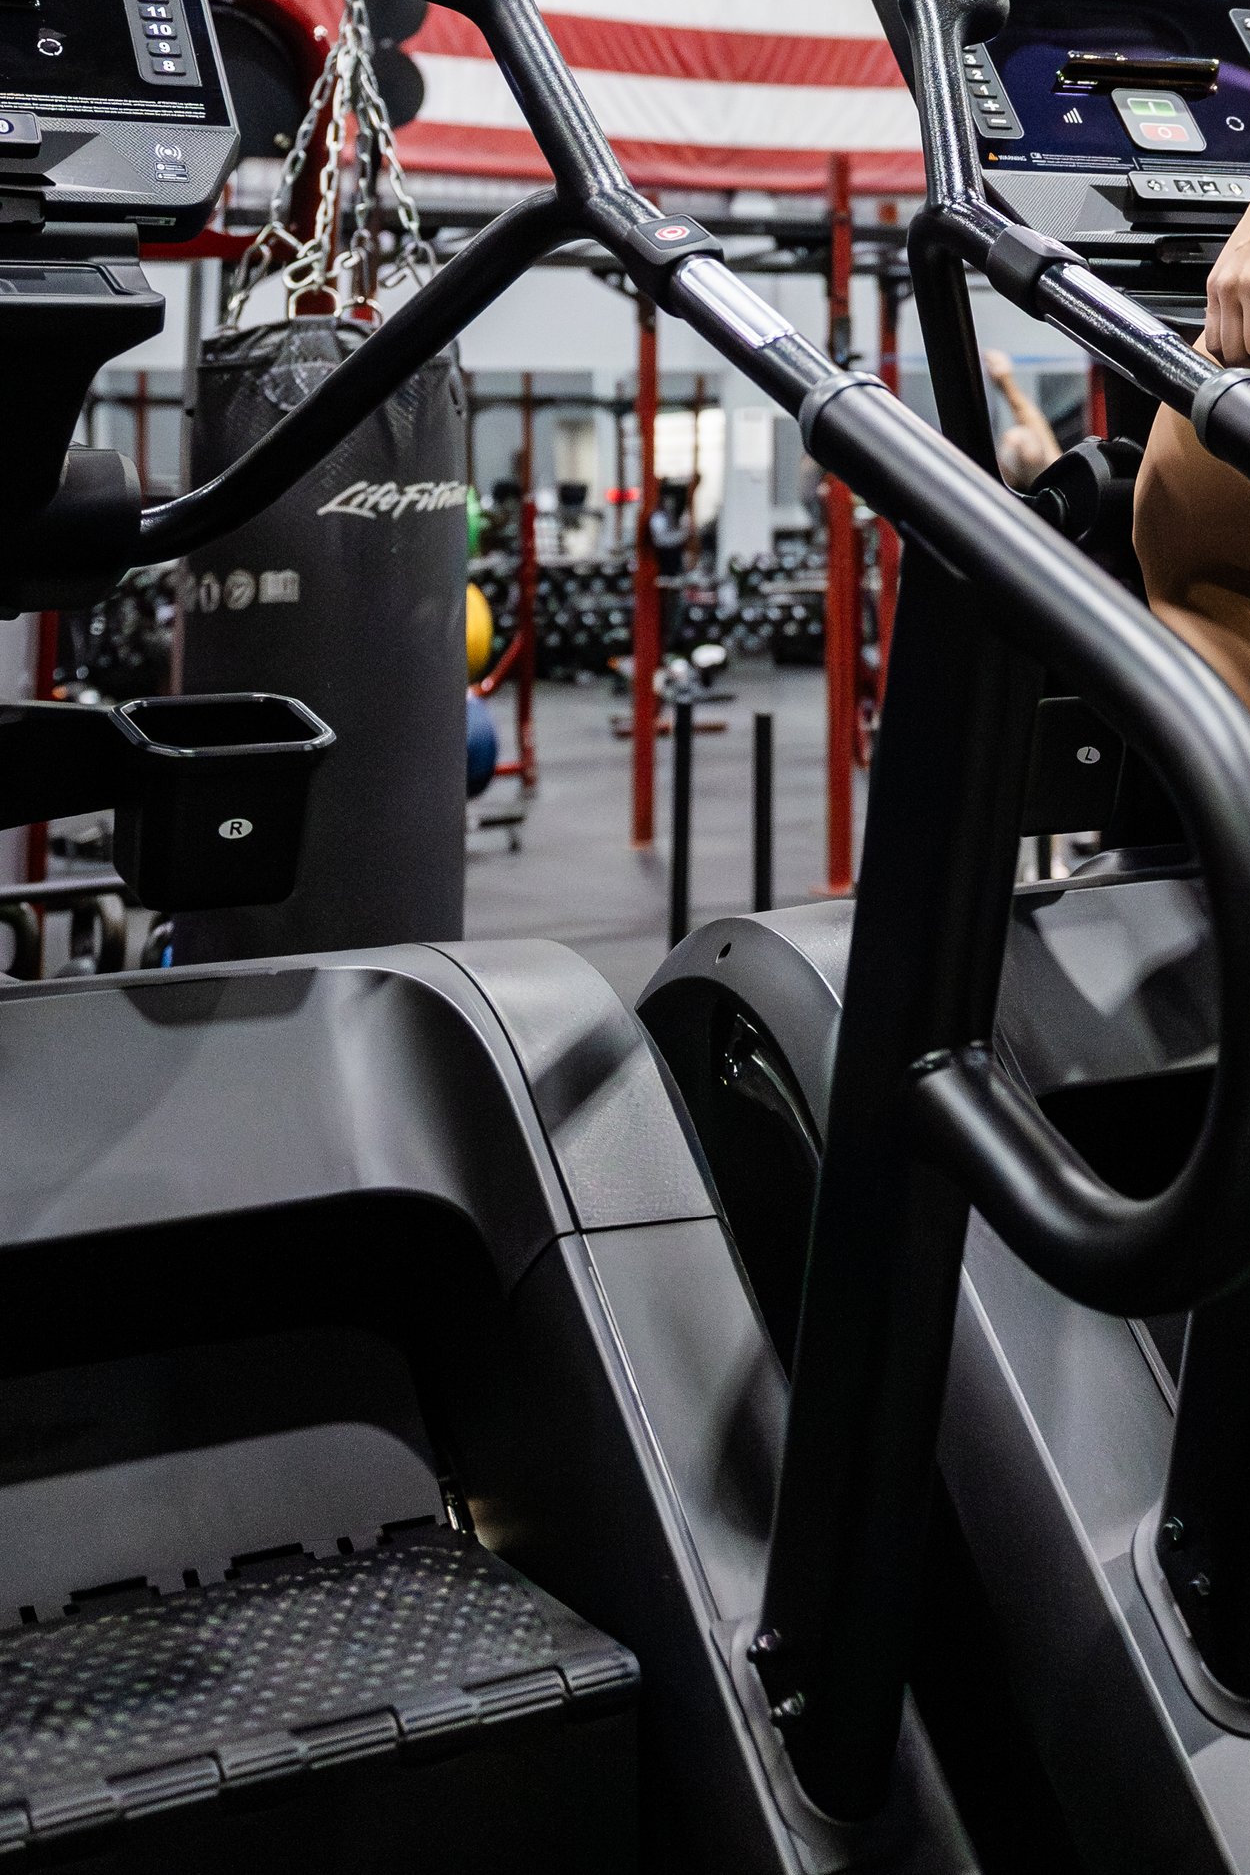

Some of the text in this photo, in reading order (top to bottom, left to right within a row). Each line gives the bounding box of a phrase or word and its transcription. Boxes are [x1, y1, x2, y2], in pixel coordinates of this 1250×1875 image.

[147, 6, 167, 18] 11
[149, 24, 172, 36] 10
[158, 42, 170, 54] 9
[964, 54, 977, 65] 3
[163, 60, 175, 72] 8
[971, 69, 984, 80] 2
[979, 85, 989, 95] 1
[229, 821, 243, 836] R
